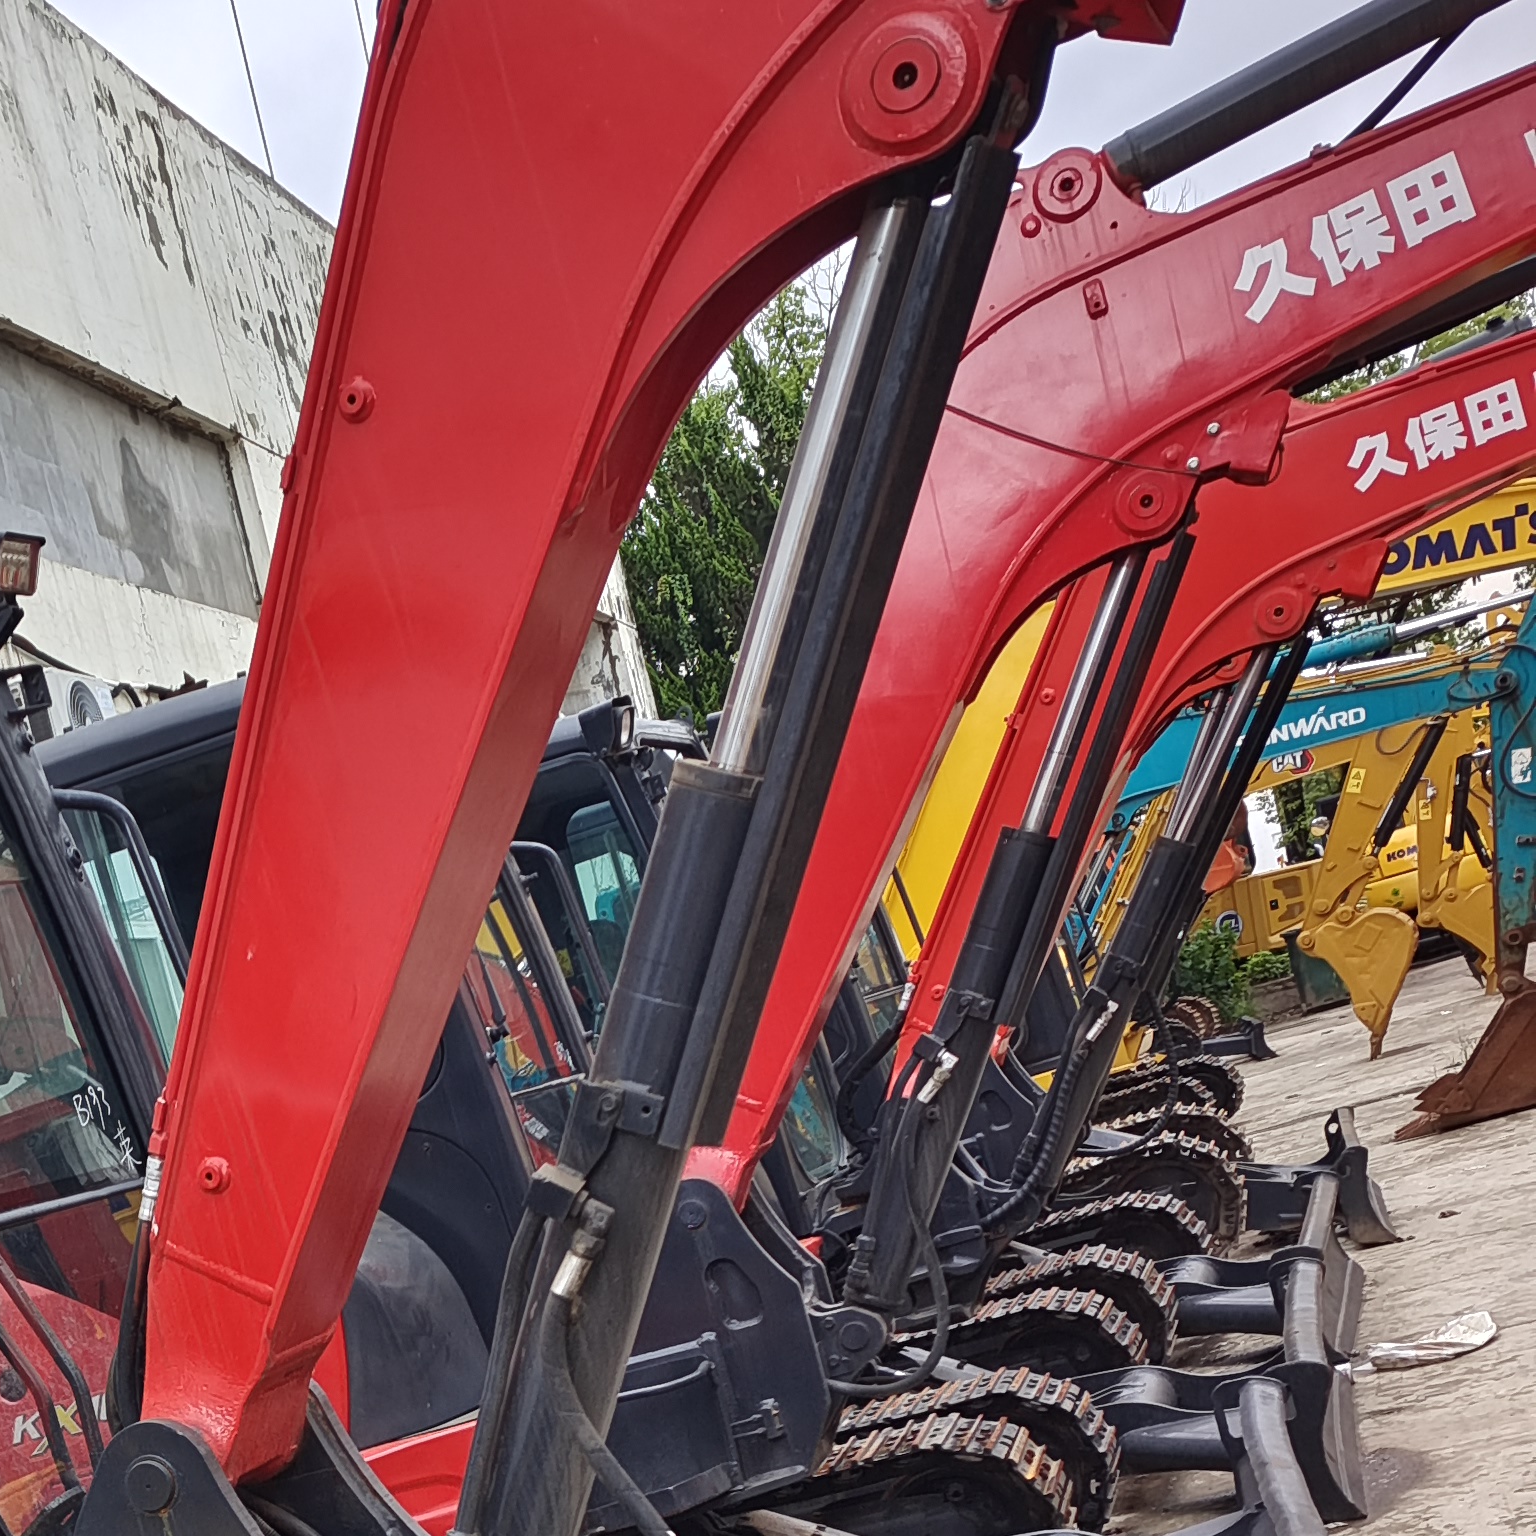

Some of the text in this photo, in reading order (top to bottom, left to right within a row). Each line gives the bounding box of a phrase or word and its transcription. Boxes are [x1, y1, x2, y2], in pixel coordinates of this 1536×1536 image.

[1234, 151, 1477, 324] 久保田
[1347, 378, 1528, 493] 久保田
[1235, 705, 1367, 747] NWARD
[1271, 749, 1303, 773] CAT
[12, 1393, 108, 1456] KX1
